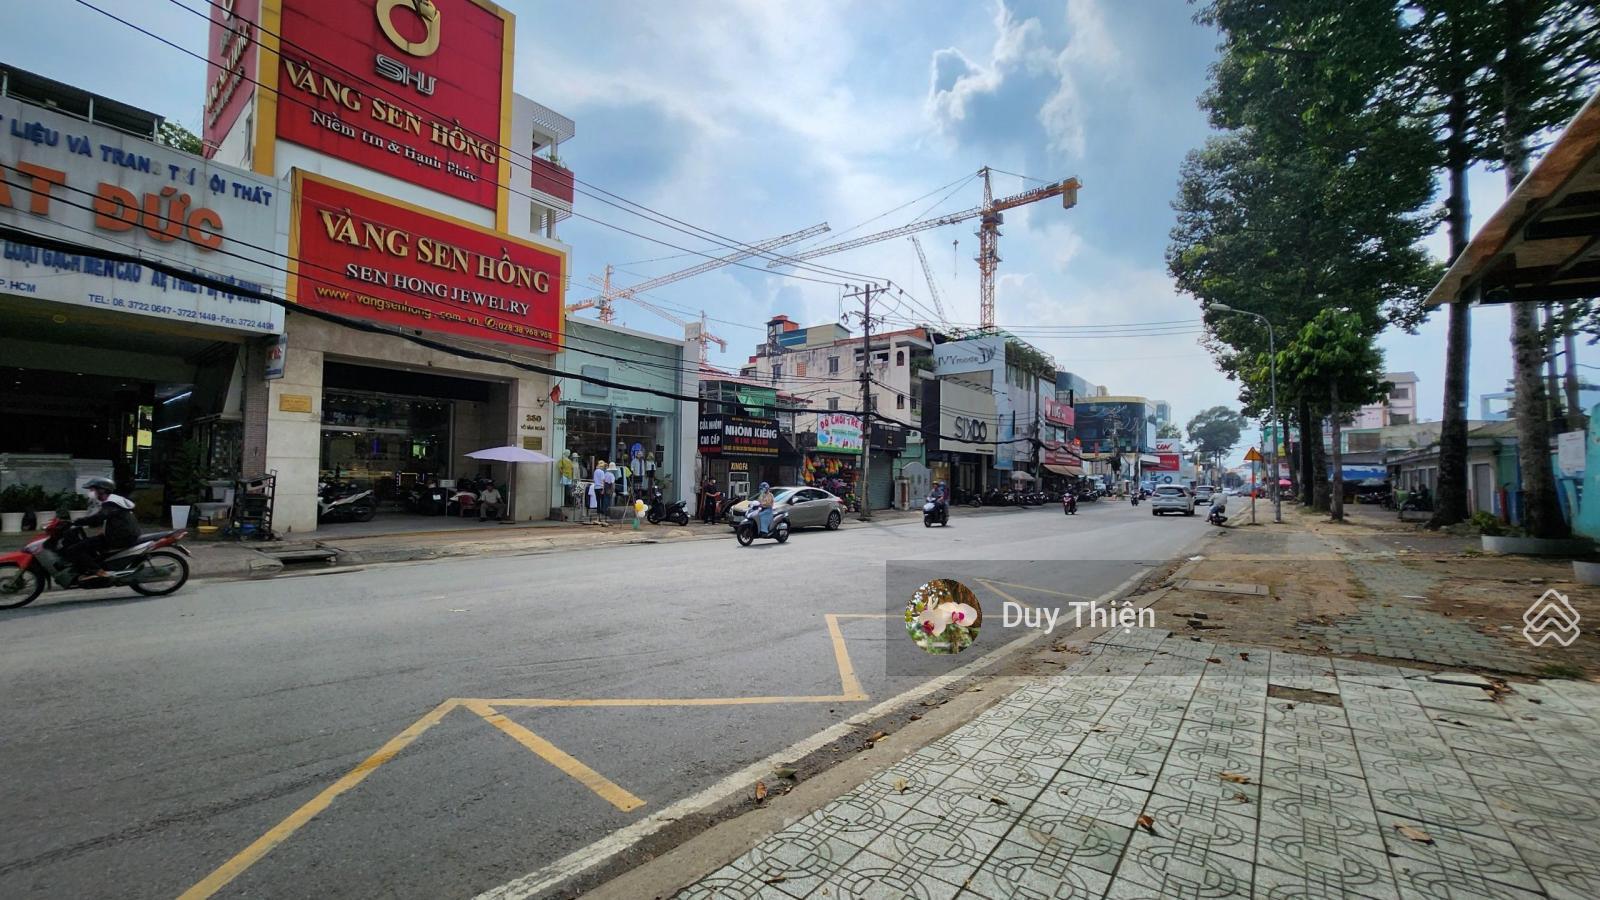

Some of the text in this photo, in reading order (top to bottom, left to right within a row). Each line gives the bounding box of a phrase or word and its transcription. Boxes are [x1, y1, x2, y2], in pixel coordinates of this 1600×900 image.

[284, 61, 362, 112] VÀNG
[371, 97, 422, 136] SEN
[431, 119, 497, 165] HỒNG
[311, 111, 356, 138] Niềm
[10, 118, 60, 147] LIỆU
[66, 134, 93, 158] VÀ
[232, 182, 273, 206] THẤT
[94, 182, 223, 254] ĐỨC
[319, 207, 551, 294] VÀNG SEN HỒNG
[10, 281, 37, 294] HCM
[347, 263, 530, 316] SEN HONG JEWELRY
[89, 294, 111, 305] TEL:
[128, 301, 150, 311] 3722
[151, 304, 172, 314] 0647
[177, 309, 196, 318] 3722
[238, 318, 256, 327] 3722
[725, 423, 778, 439] NHÔM KIẾNG
[954, 415, 988, 442] SIXDO
